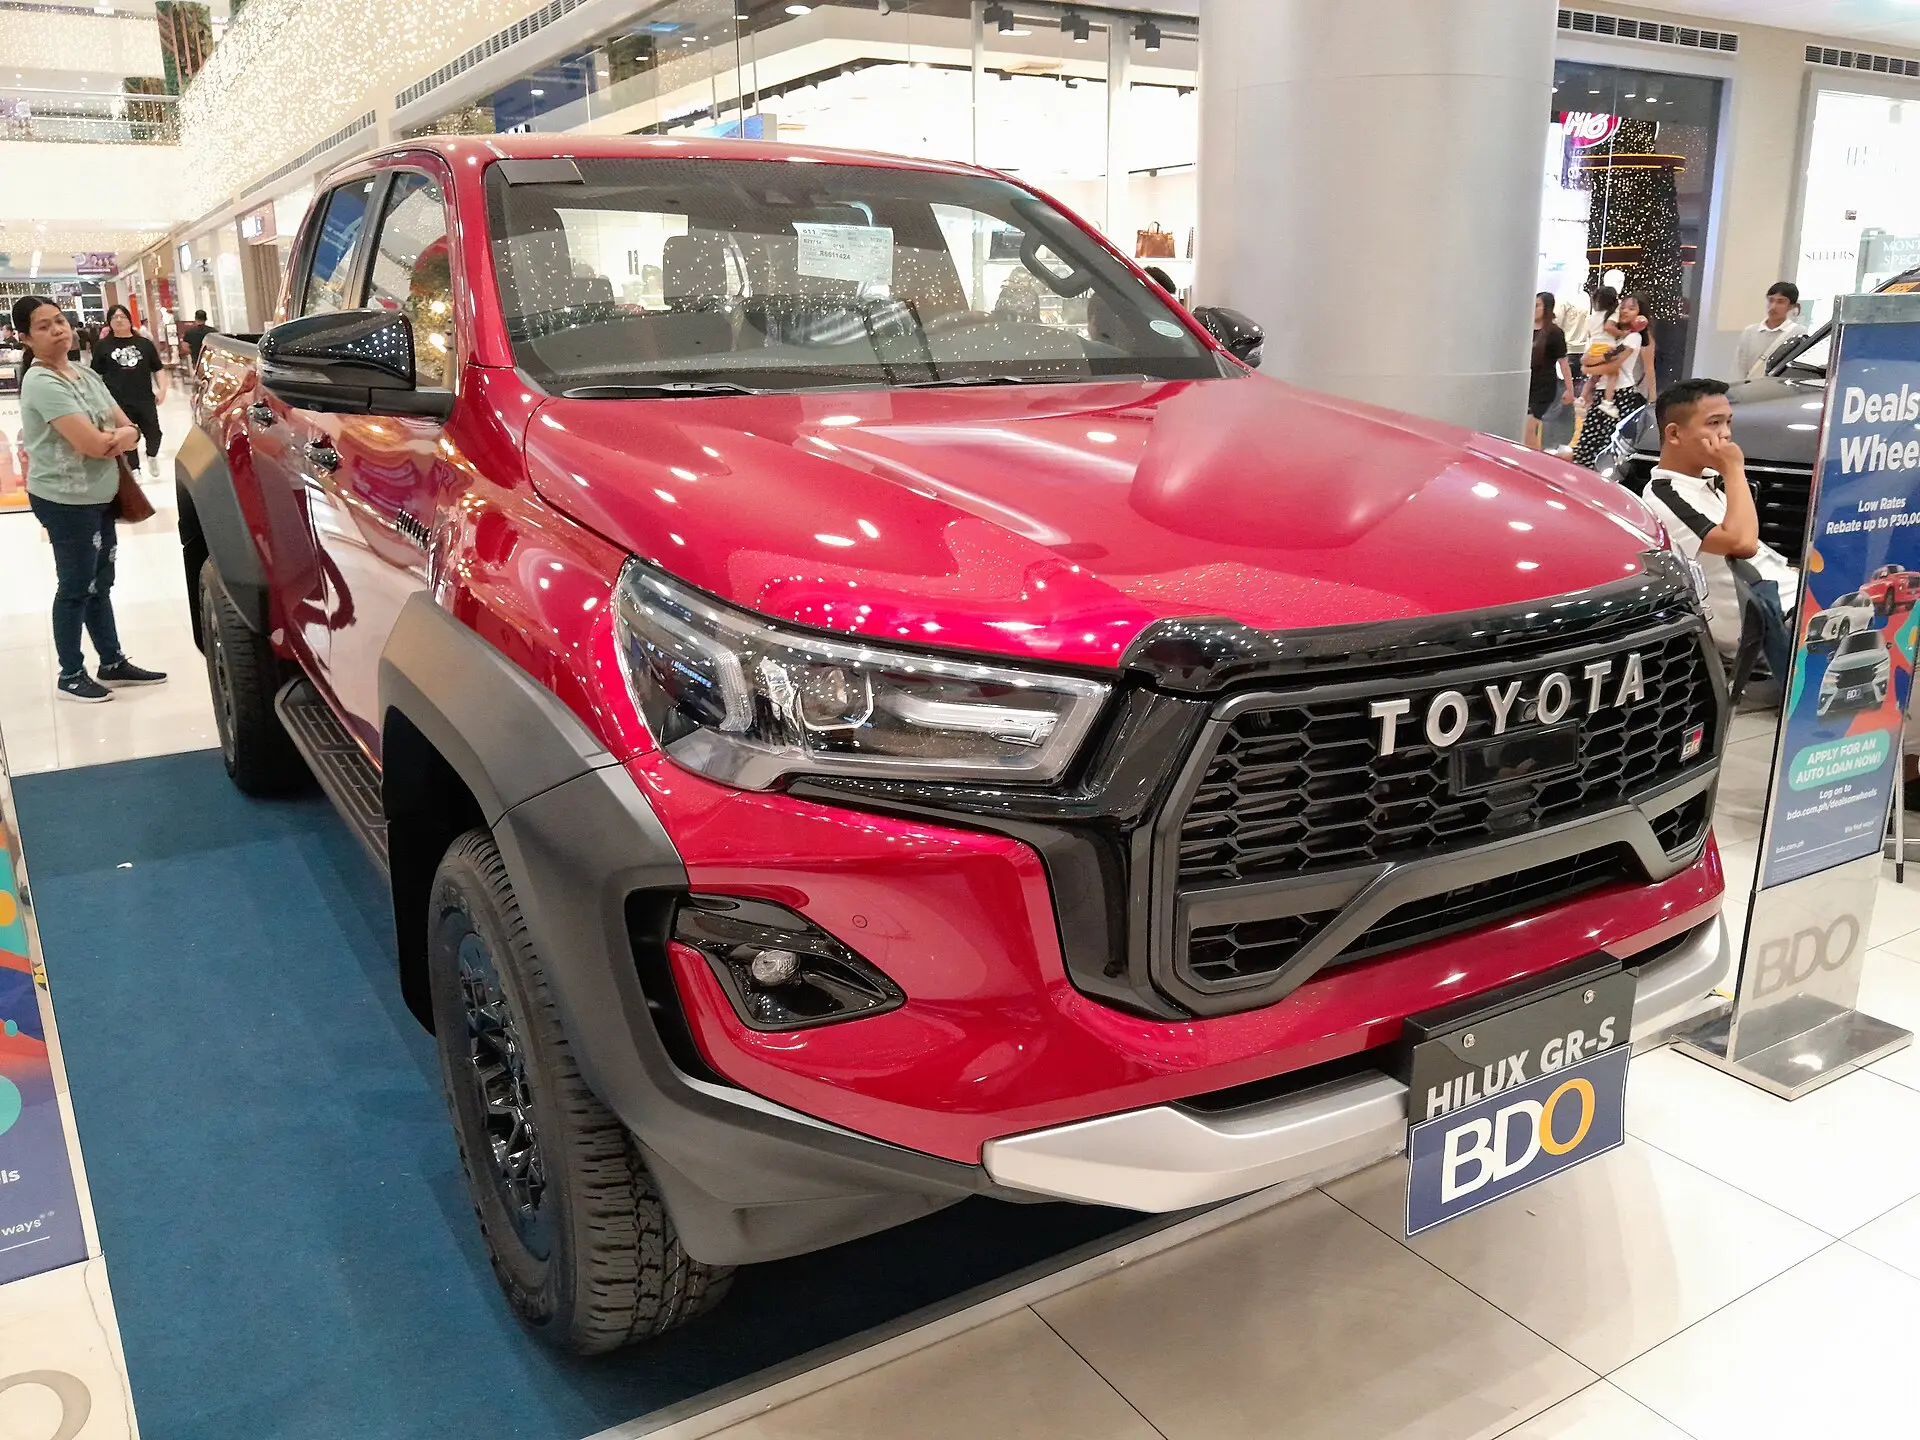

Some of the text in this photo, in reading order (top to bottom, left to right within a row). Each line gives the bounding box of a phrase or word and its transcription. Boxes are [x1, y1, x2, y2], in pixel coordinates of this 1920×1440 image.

[1842, 383, 1920, 424] Deals
[1840, 434, 1920, 474] Whee
[1858, 497, 1906, 512] Low Rates
[1826, 520, 1861, 534] Rebate
[1863, 519, 1876, 531] up
[1878, 516, 1888, 528] to
[1369, 652, 1645, 756] TOYOTA
[1795, 751, 1882, 784] AUTO LOAN NOW!
[1807, 738, 1877, 766] APPLY FOR AN
[1819, 784, 1853, 801] Log on to
[1752, 913, 1860, 1001] BDO
[1426, 1016, 1616, 1118] HILUX GR-S
[1441, 1077, 1595, 1204] BDO
[0, 1169, 20, 1185] ls
[1, 1219, 42, 1236] ways
